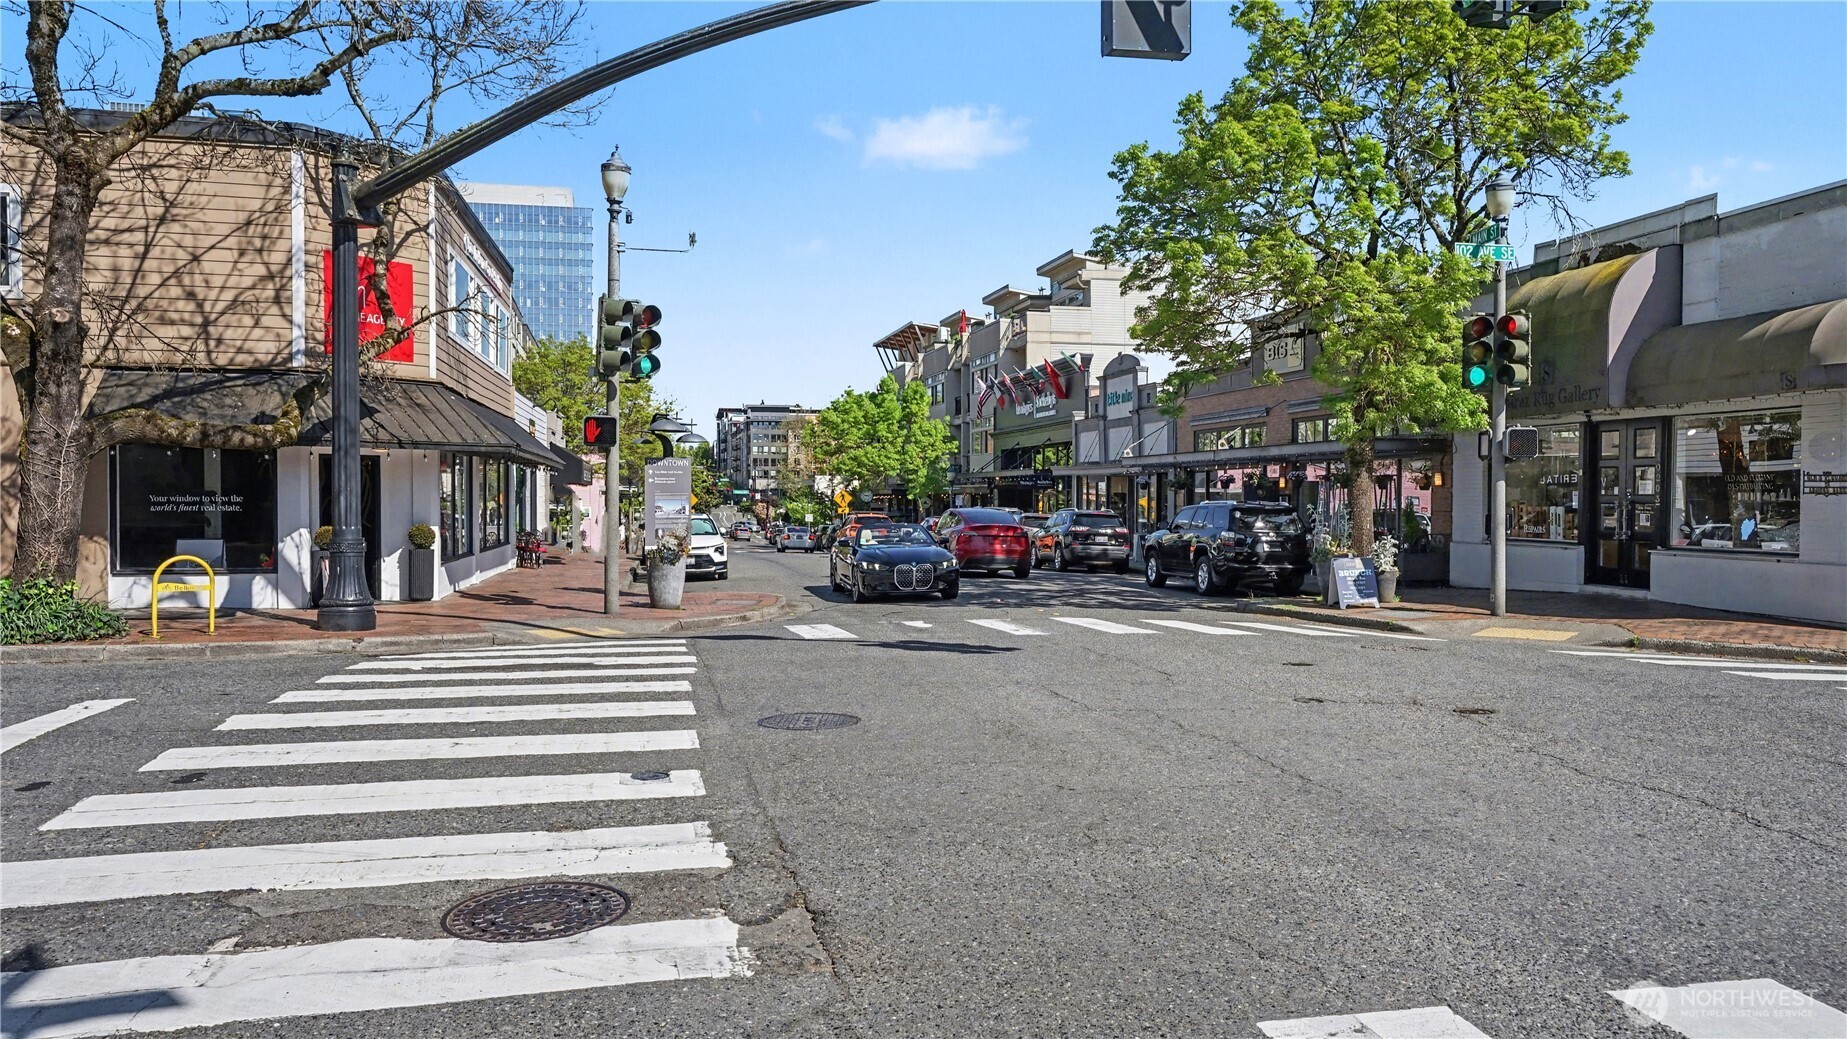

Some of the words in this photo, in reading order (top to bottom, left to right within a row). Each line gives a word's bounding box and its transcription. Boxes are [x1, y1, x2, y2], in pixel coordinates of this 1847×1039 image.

[1473, 229, 1488, 244] MAIN
[1490, 225, 1497, 239] ST
[1456, 244, 1473, 259] 102
[1479, 246, 1496, 259] AVE
[1501, 246, 1514, 259] SE
[1534, 391, 1555, 409] Rug
[1558, 385, 1600, 405] Gallery
[149, 494, 168, 502] Your
[169, 494, 200, 502] window
[211, 494, 229, 502] view
[231, 494, 243, 502] the
[150, 503, 177, 512] world's
[178, 503, 199, 512] finest
[200, 503, 216, 512] real
[217, 504, 243, 512] estate.
[1338, 569, 1372, 577] BRUNCH
